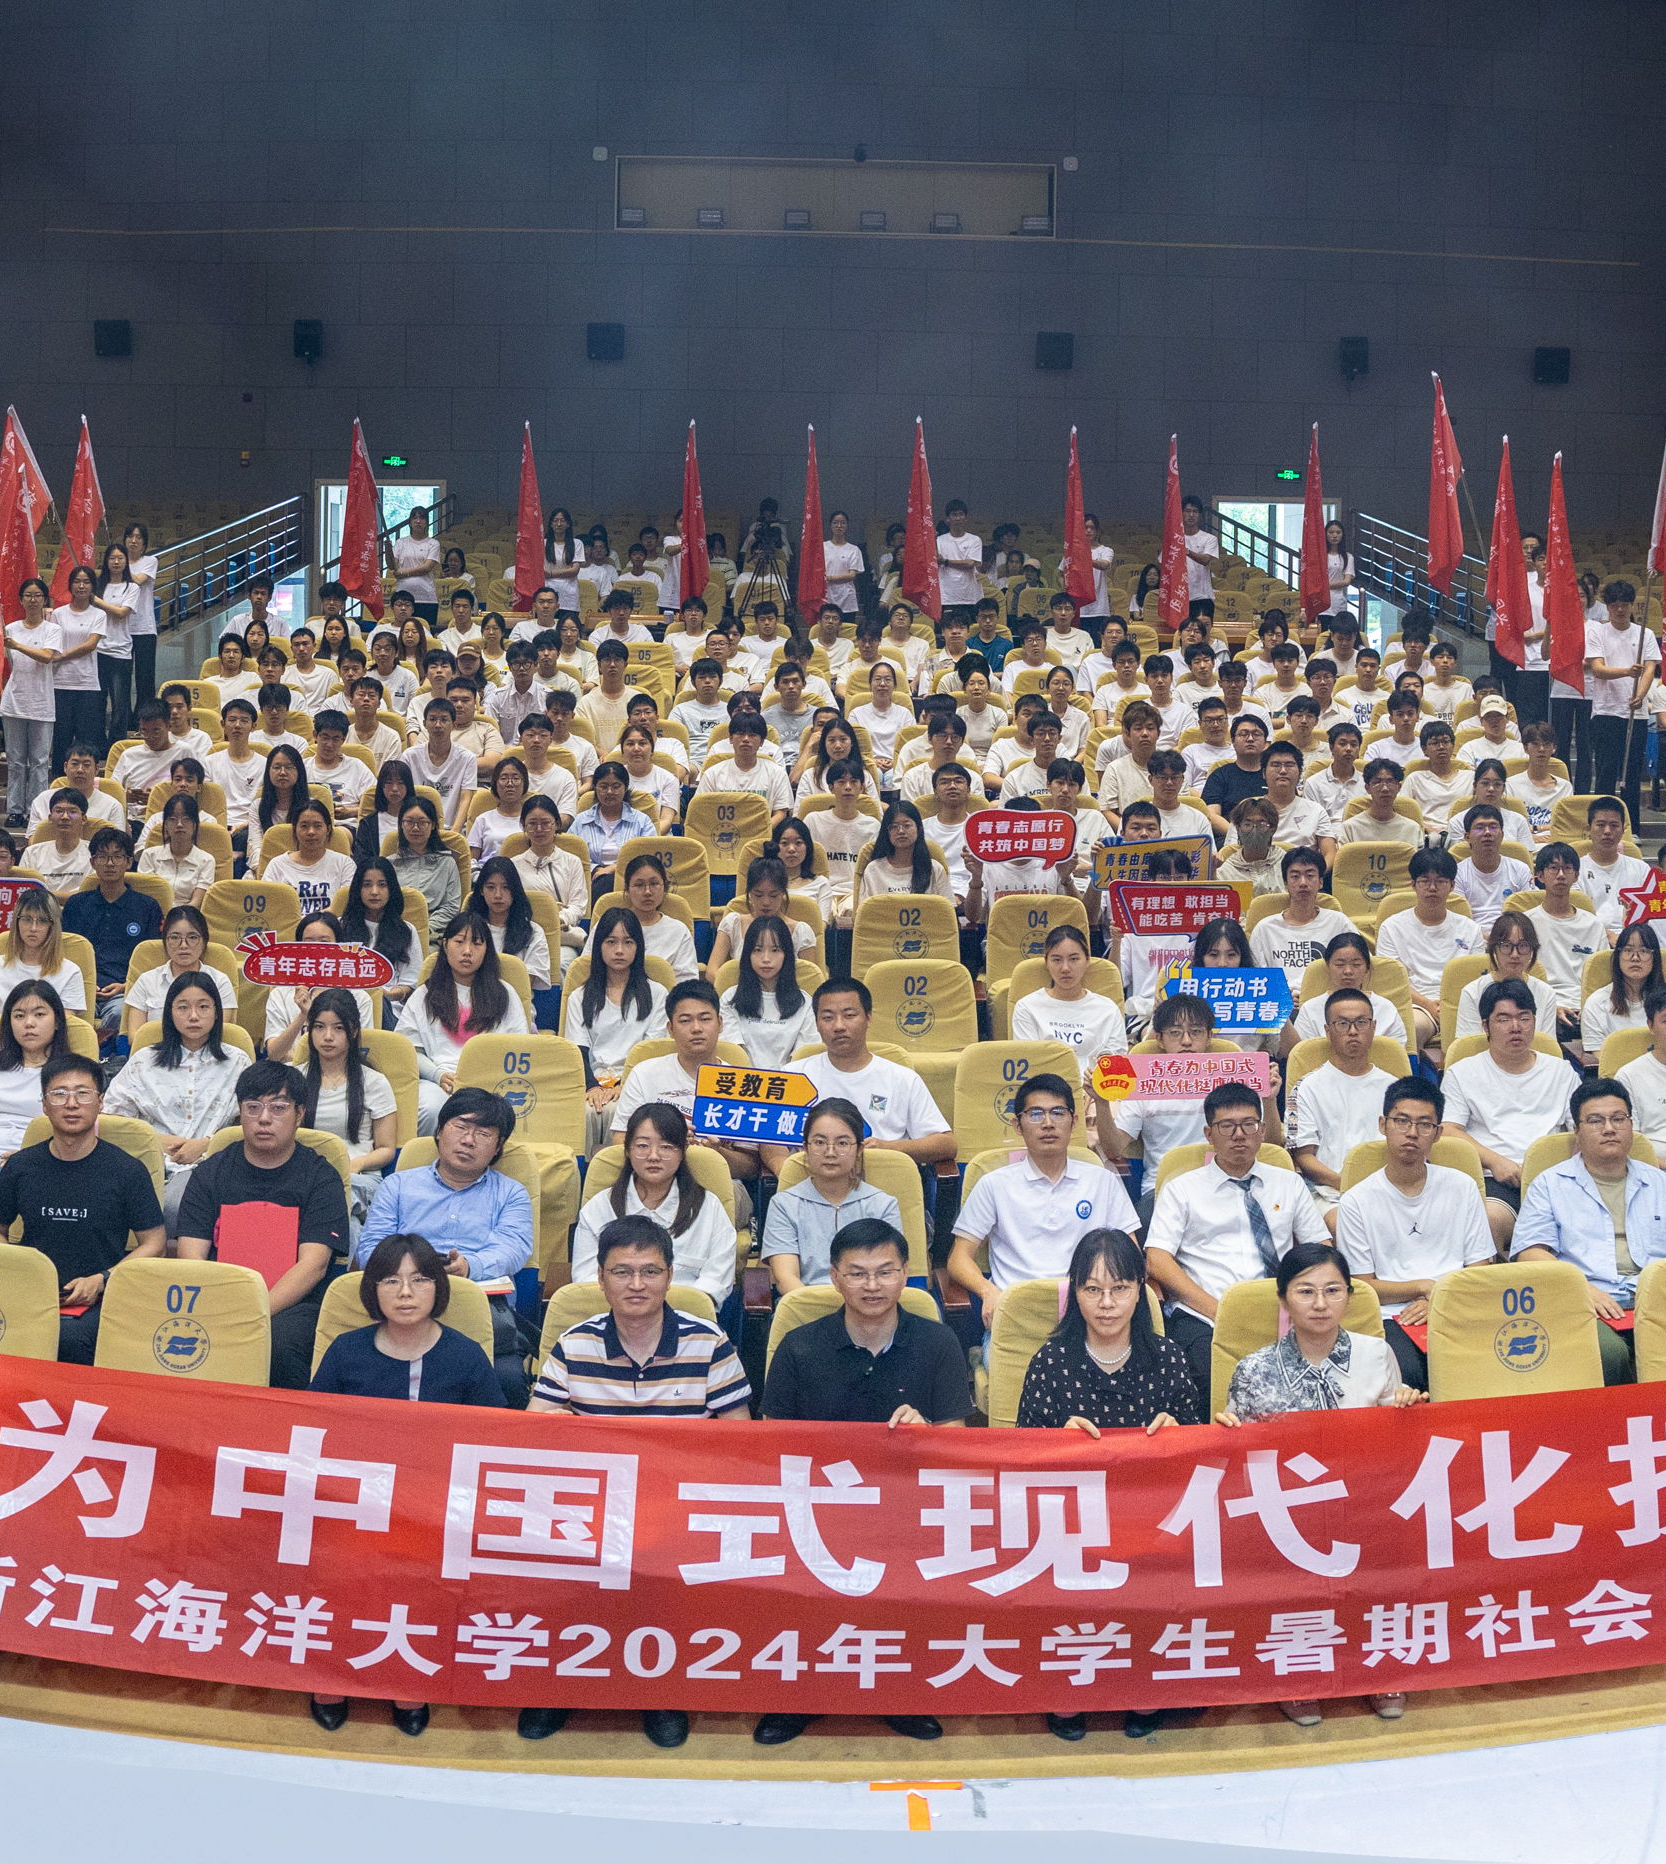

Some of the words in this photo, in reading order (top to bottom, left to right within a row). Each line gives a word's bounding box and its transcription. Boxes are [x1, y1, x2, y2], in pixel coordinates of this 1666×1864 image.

[638, 649, 650, 660] 05
[625, 674, 637, 685] 05
[717, 804, 734, 820] 03
[978, 819, 1064, 834] 青春志愿行
[979, 837, 1065, 852] 共筑中国梦
[827, 852, 847, 861] HATE
[1369, 854, 1385, 870] 10
[244, 895, 265, 913] 09
[1131, 896, 1176, 910] 有理想
[1185, 894, 1229, 909] 敢担当
[899, 909, 920, 926] 02
[1028, 911, 1048, 928] 04
[1139, 913, 1183, 926] 能吃苦
[1287, 941, 1310, 951] THE
[1272, 950, 1310, 960] NORTH
[1283, 959, 1308, 968] FACE
[259, 955, 377, 979] 青年志存高远
[904, 976, 927, 996] 02
[1179, 977, 1268, 999] 用行动书
[1213, 1001, 1280, 1022] 写青春
[1054, 1030, 1084, 1045] NYC
[504, 1052, 530, 1074] 05
[1003, 1060, 1029, 1081] 02
[1149, 1059, 1256, 1076] 青春为中国式
[715, 1072, 789, 1101] 受教育
[703, 1102, 769, 1133] 长才干
[166, 1285, 201, 1314] 07
[1504, 1287, 1534, 1315] 06
